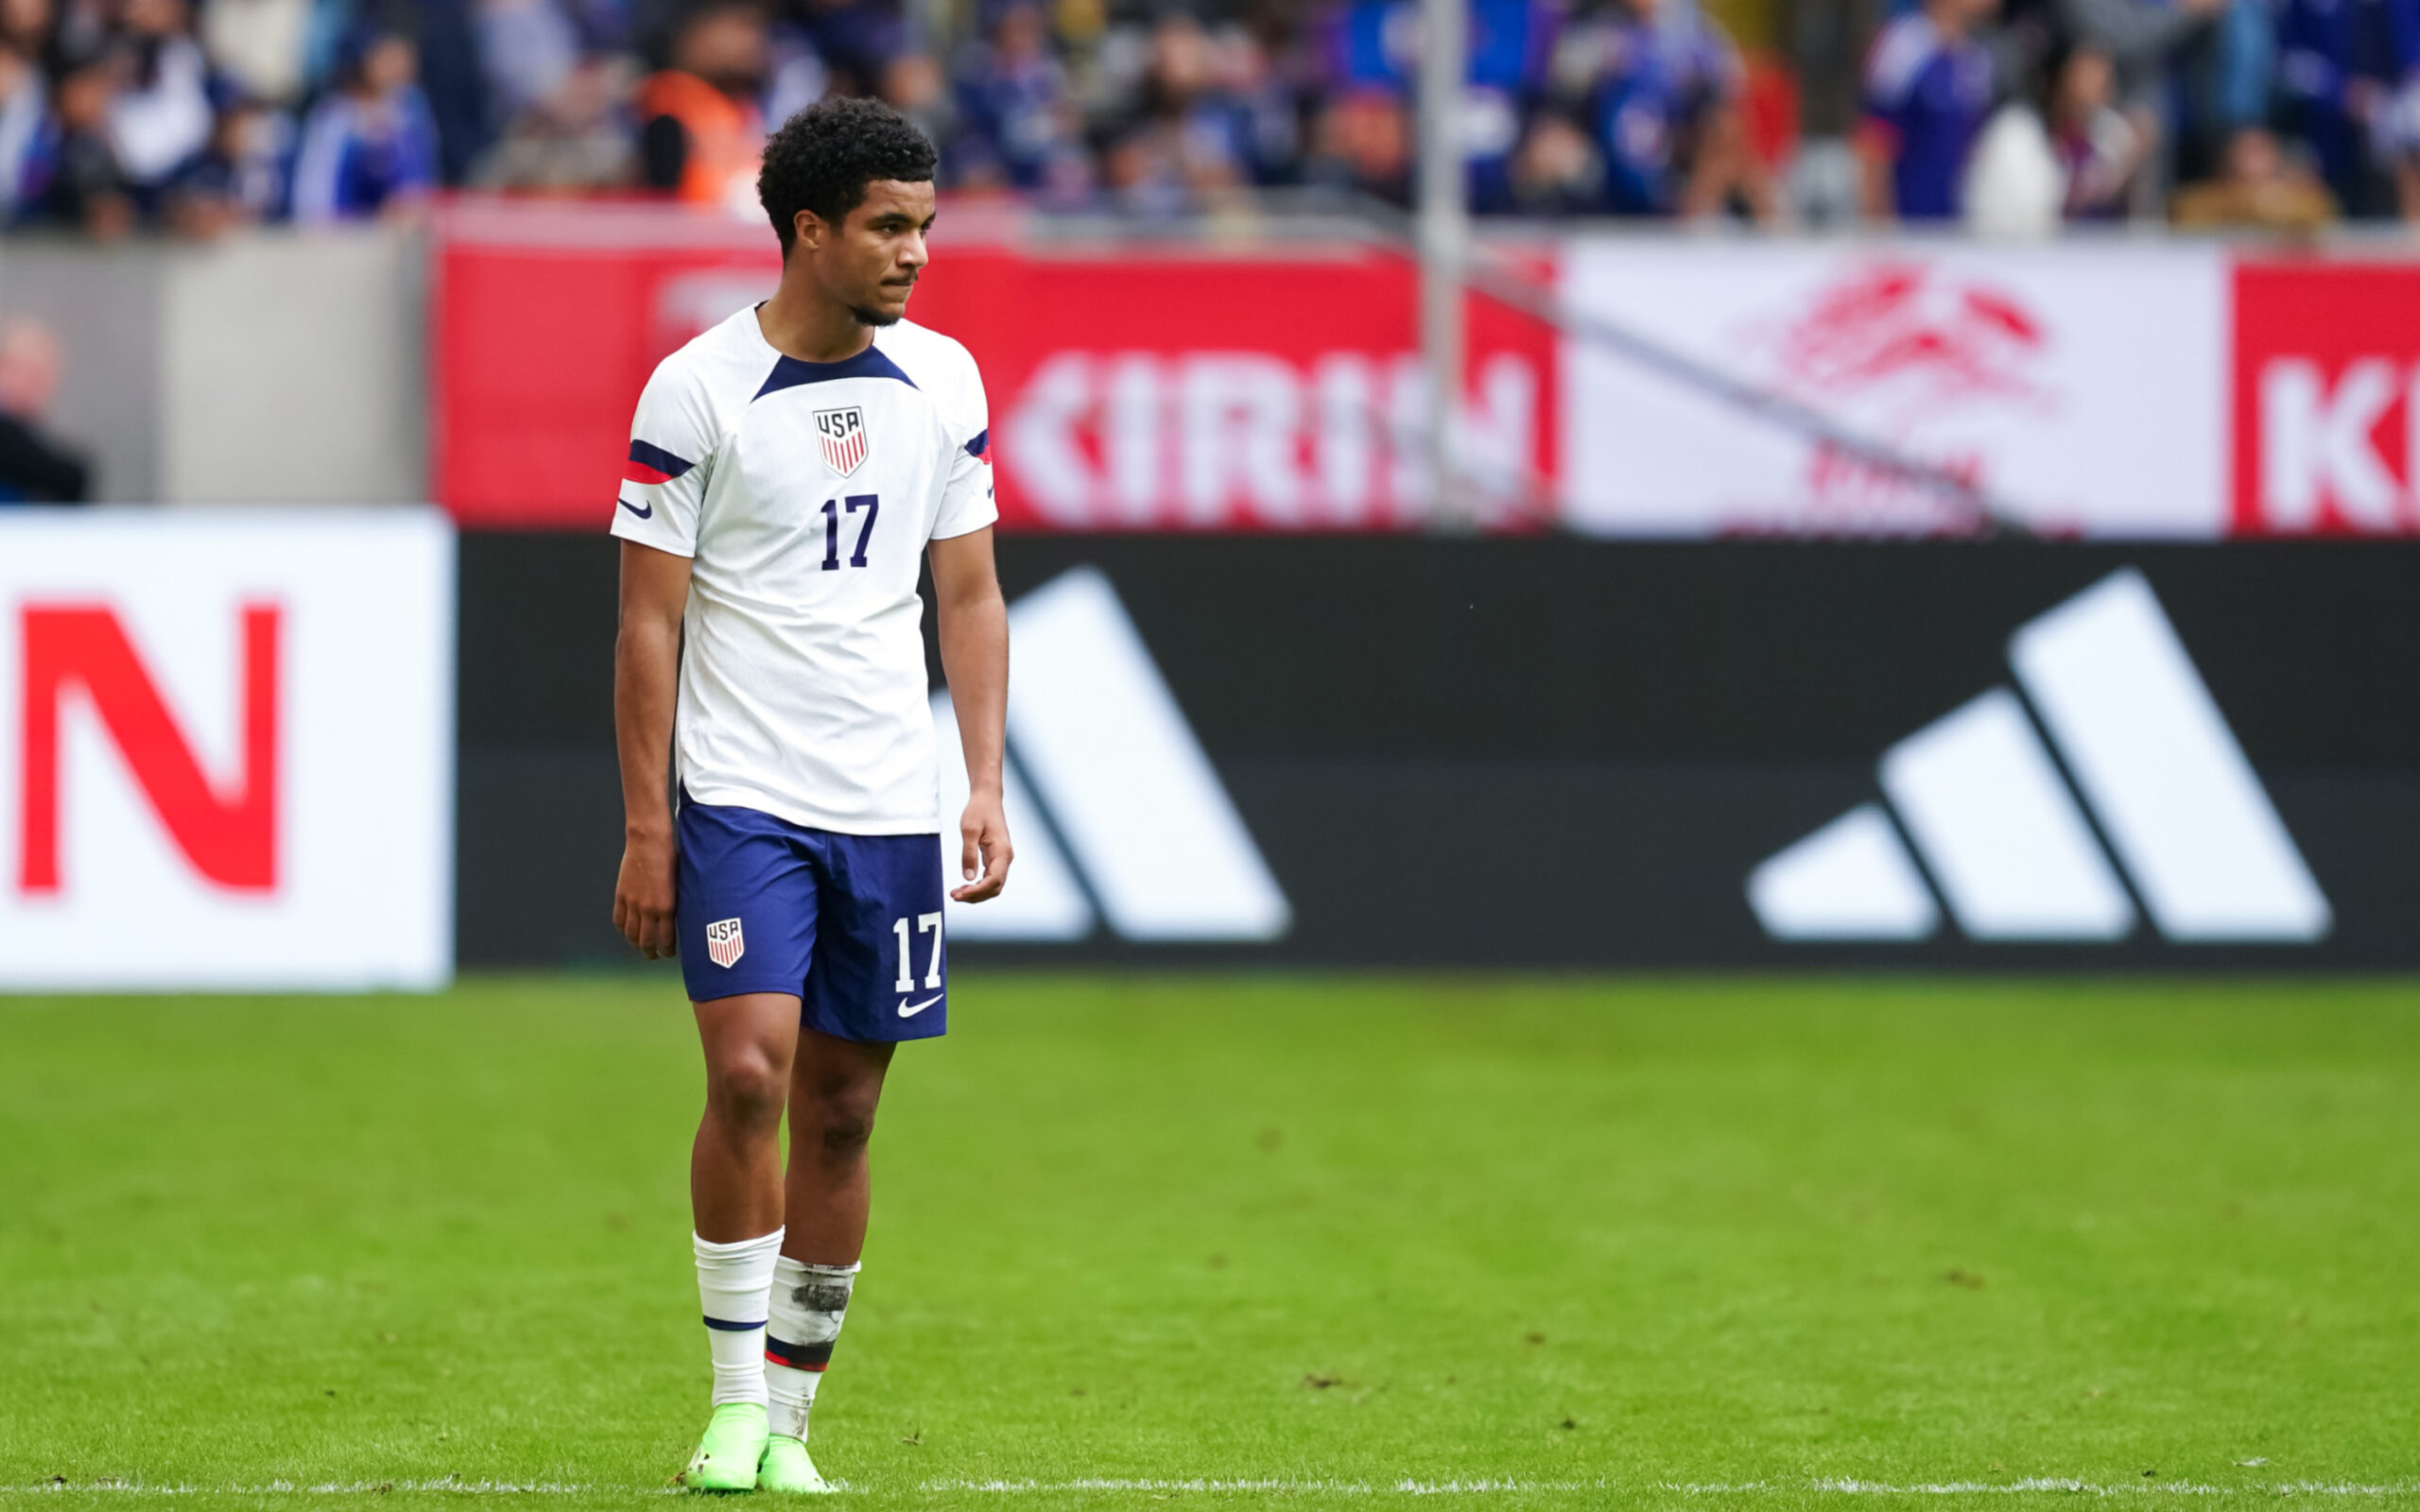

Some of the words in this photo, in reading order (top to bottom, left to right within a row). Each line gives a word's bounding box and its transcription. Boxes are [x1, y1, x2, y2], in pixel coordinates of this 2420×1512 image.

[818, 411, 859, 438] USA
[821, 494, 879, 571] 17
[18, 603, 282, 896] N
[709, 920, 739, 941] USA
[893, 911, 942, 993] 17
